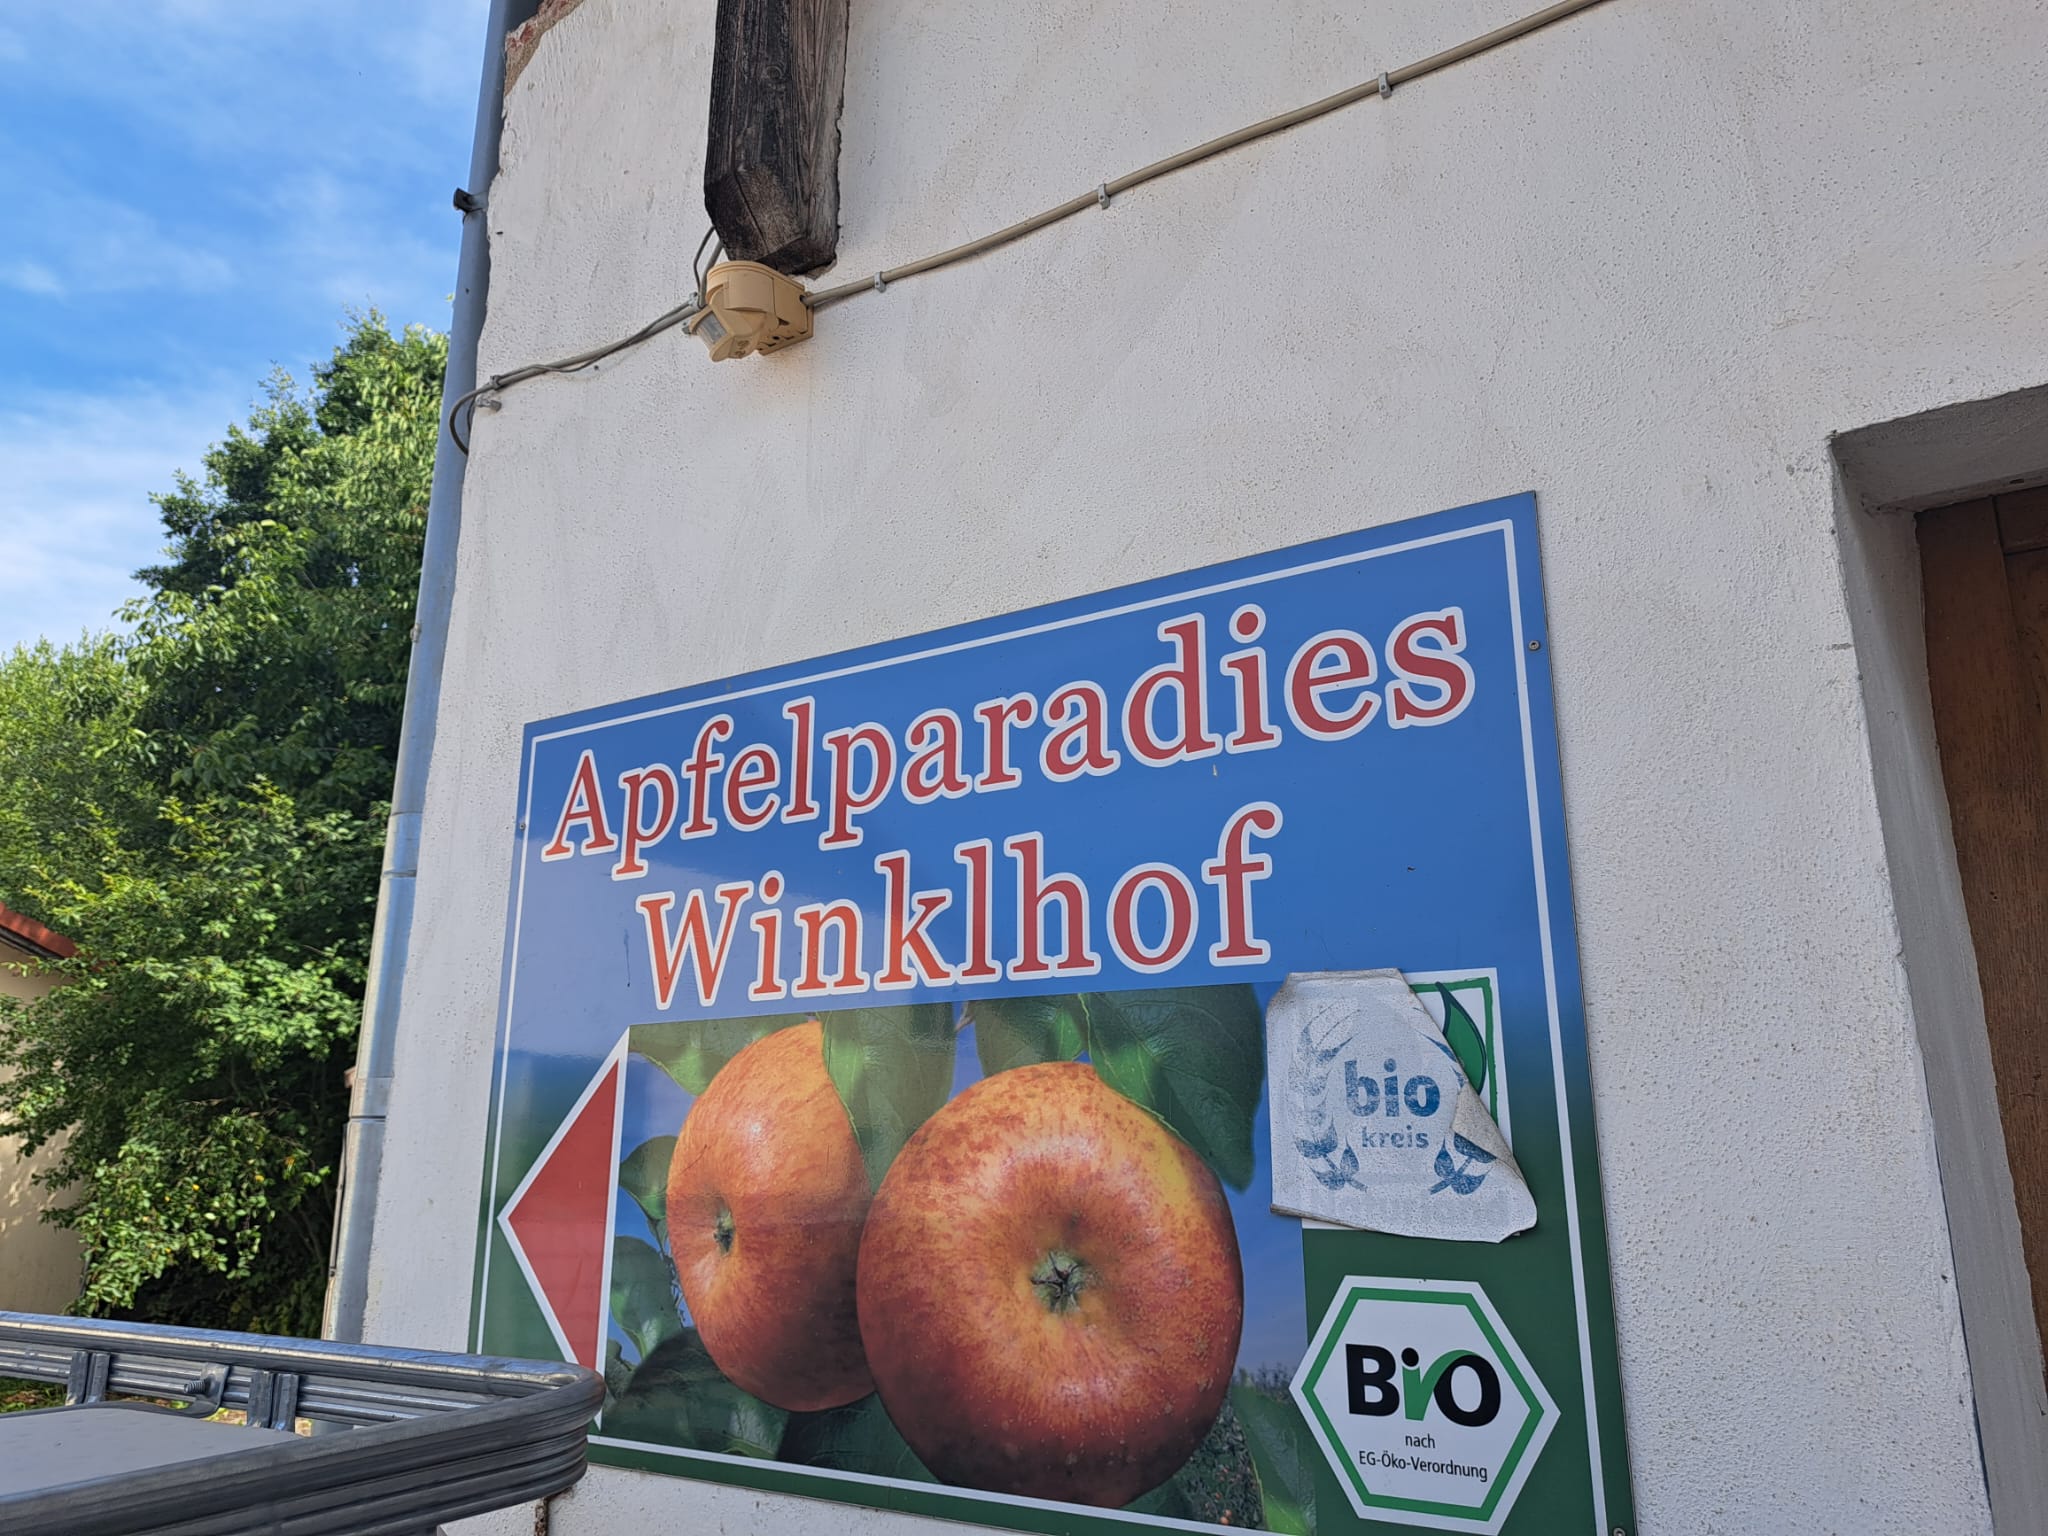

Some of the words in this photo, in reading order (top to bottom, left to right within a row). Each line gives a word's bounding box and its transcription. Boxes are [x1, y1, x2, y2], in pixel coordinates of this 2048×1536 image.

[540, 603, 1475, 880] Apfelparadies
[637, 802, 1284, 1010] Winklhof
[1344, 1058, 1441, 1118] bio
[1361, 1125, 1430, 1149] kreis
[1405, 1434, 1436, 1449] nach
[1359, 1450, 1488, 1483] EG-Öko-Verordnung
